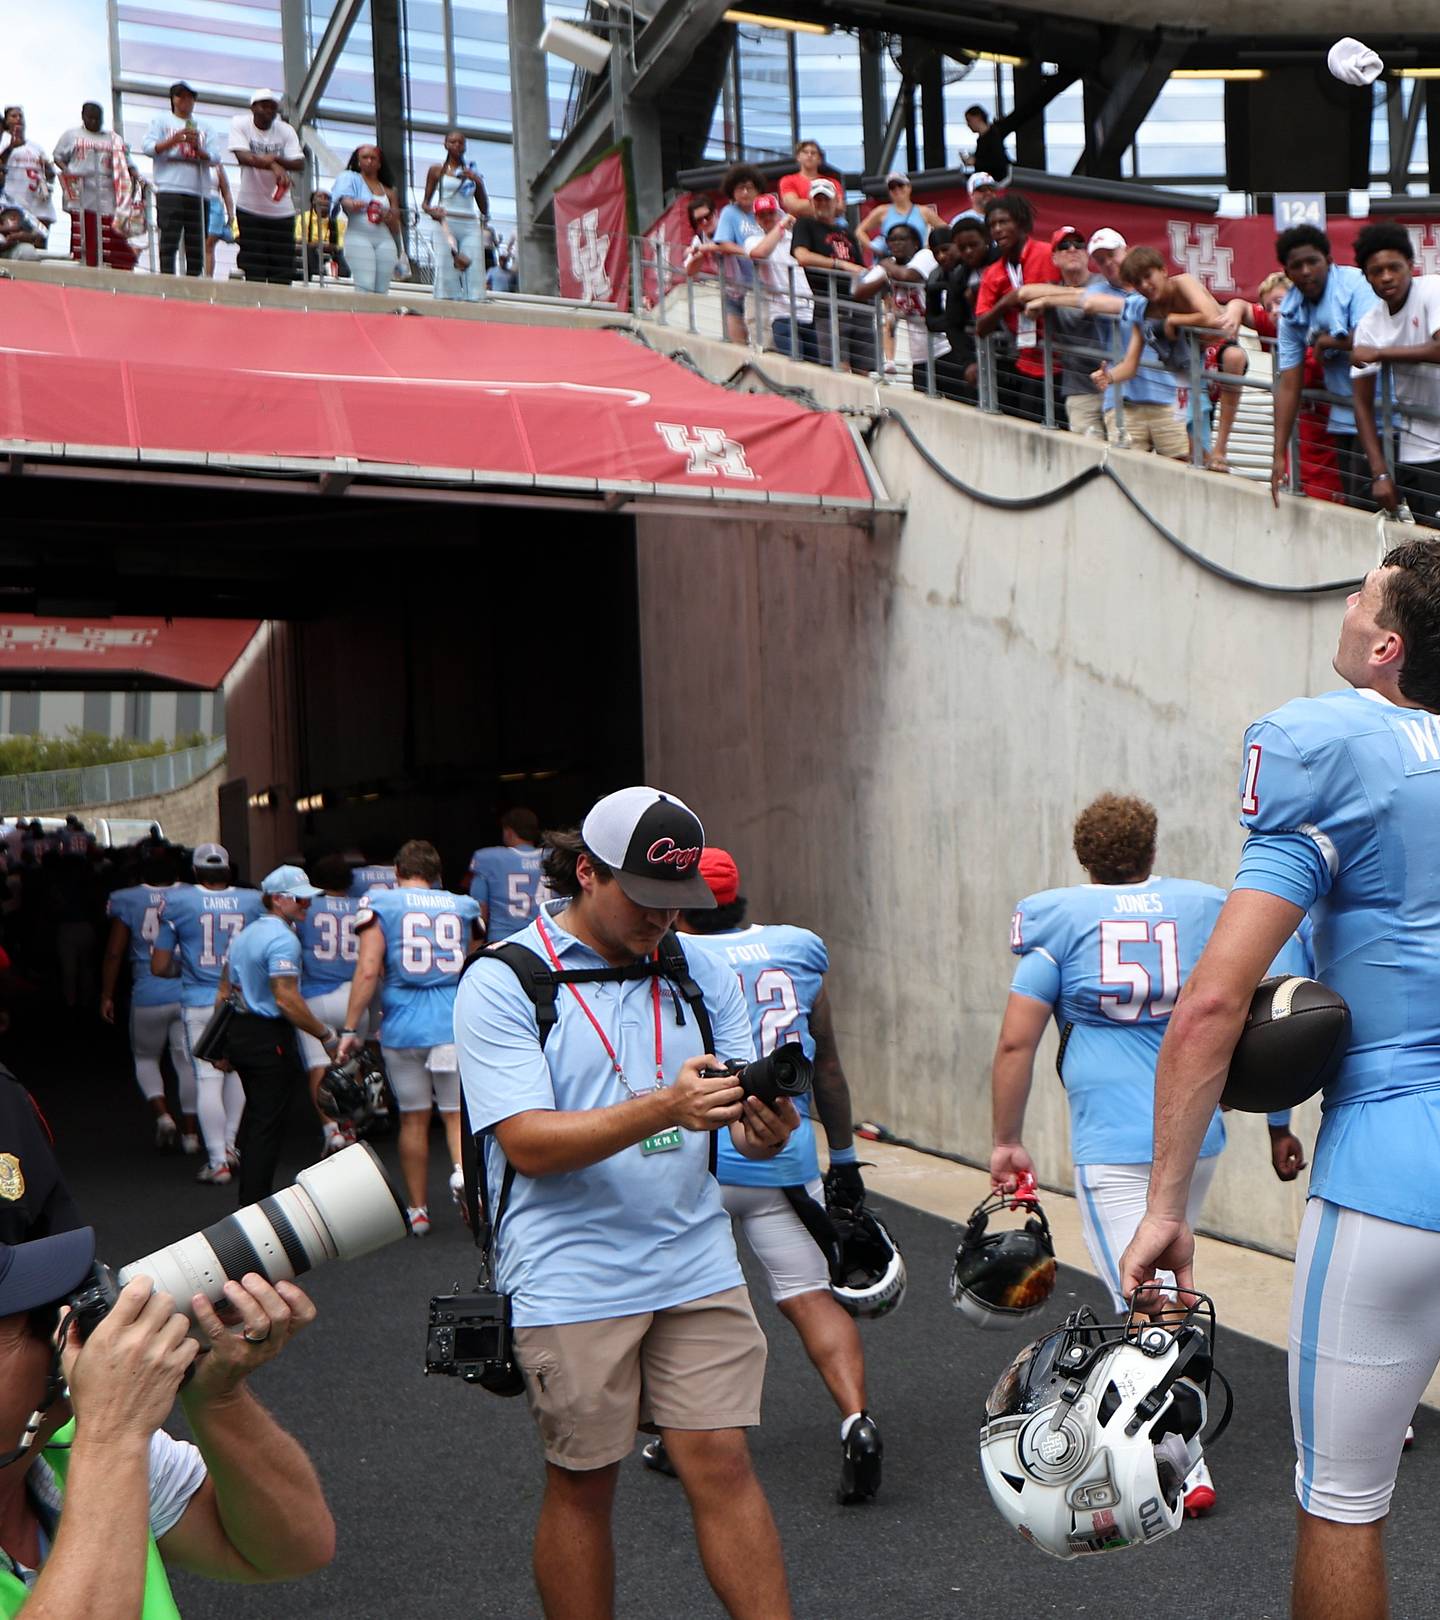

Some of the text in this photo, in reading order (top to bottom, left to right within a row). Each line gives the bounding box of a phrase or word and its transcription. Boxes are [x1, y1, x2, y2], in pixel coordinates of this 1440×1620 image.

[1281, 201, 1320, 223] 124
[1168, 220, 1236, 292] UH
[655, 420, 755, 480] UH
[1241, 744, 1261, 815] 1
[203, 896, 239, 910] CARNEY
[406, 893, 456, 909] EDWARDS
[1113, 892, 1163, 913] JONES
[402, 912, 464, 974] 69
[726, 943, 771, 963] FOTU
[1100, 920, 1181, 1023] 51
